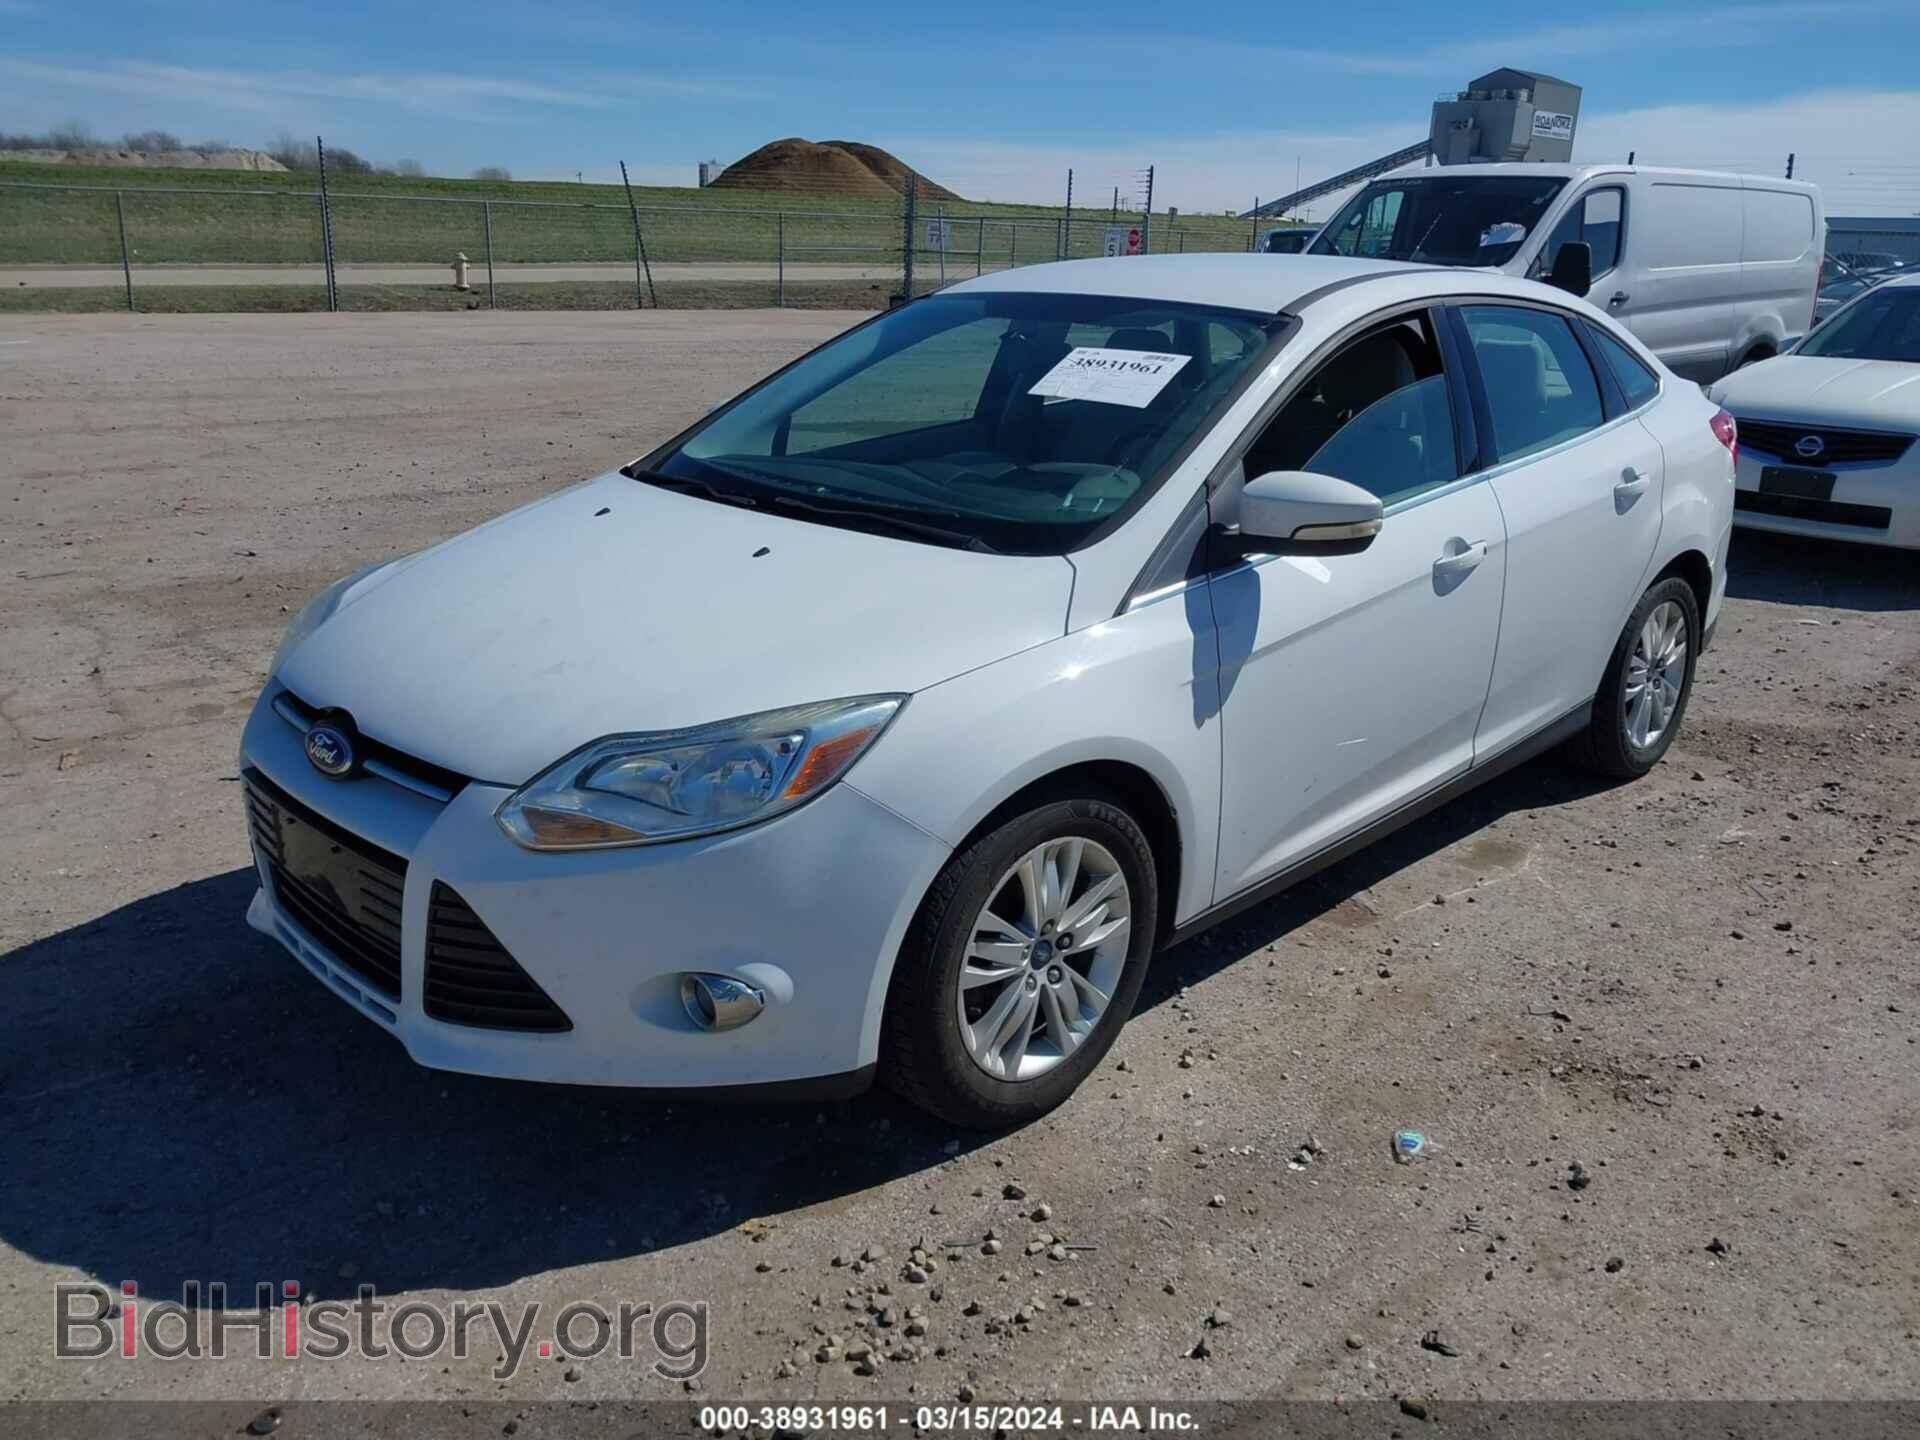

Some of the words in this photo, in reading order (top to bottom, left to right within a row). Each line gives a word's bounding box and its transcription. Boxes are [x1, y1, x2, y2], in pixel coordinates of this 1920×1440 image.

[1535, 115, 1571, 129] ROANOKE
[1108, 244, 1115, 257] 5
[1074, 358, 1163, 375] 38931961
[310, 734, 338, 764] Ford
